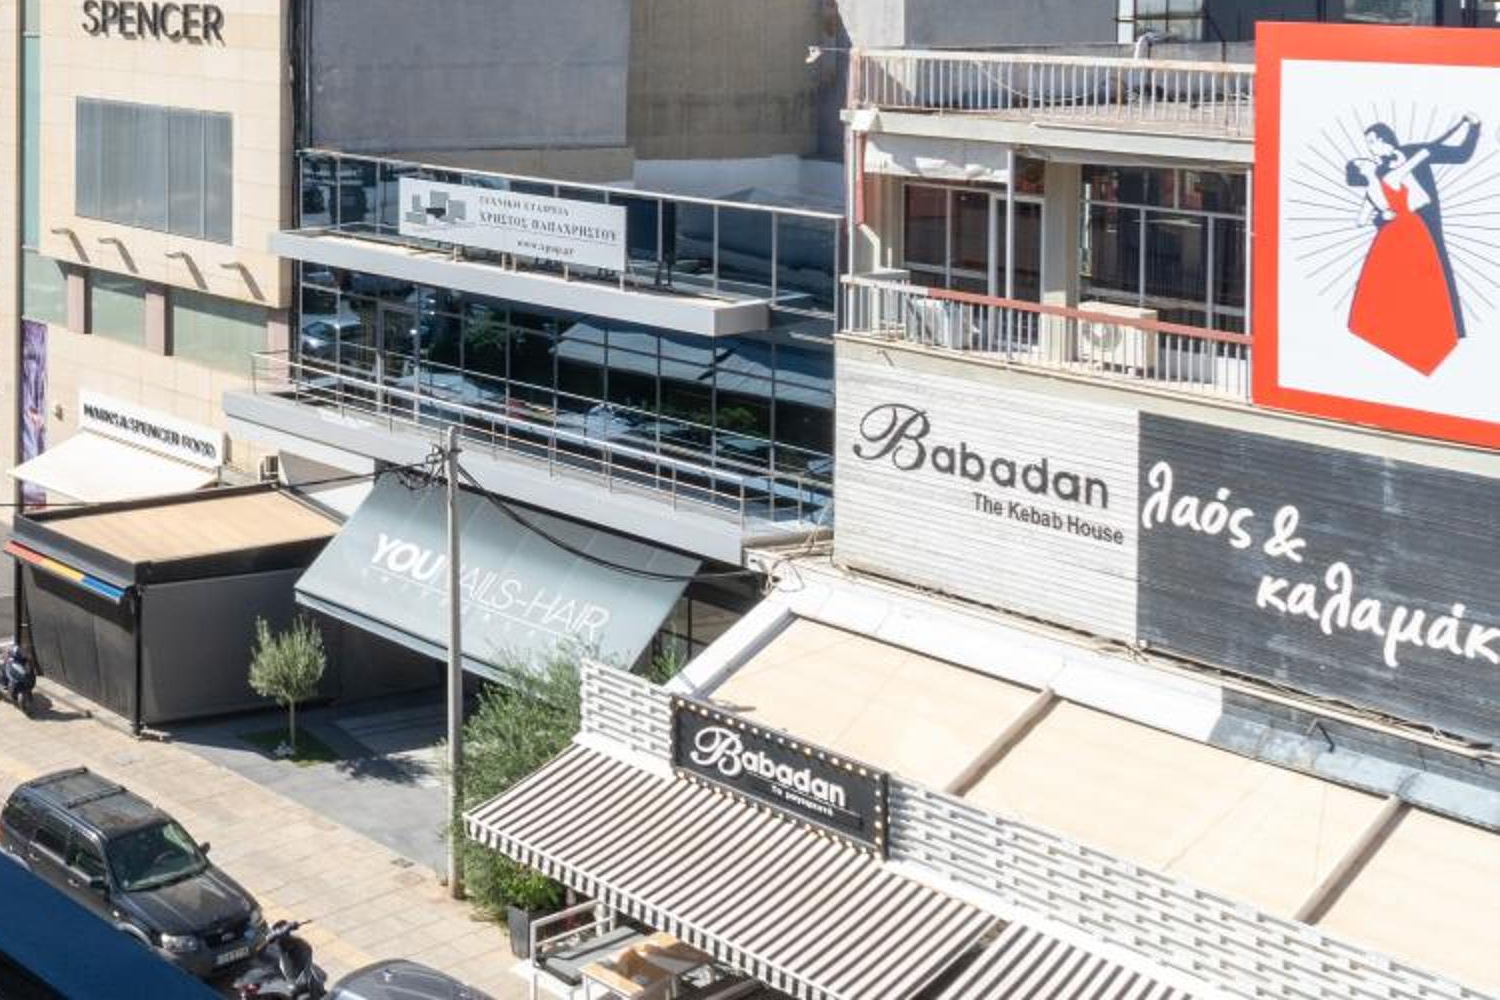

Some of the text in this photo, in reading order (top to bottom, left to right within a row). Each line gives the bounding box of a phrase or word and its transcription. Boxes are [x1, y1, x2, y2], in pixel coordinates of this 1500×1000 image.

[852, 403, 1109, 510] Babadan
[973, 491, 1125, 546] The Kebab House
[1141, 460, 1307, 563] λαός &
[371, 532, 447, 581] YOU
[689, 725, 847, 808] Babadan
